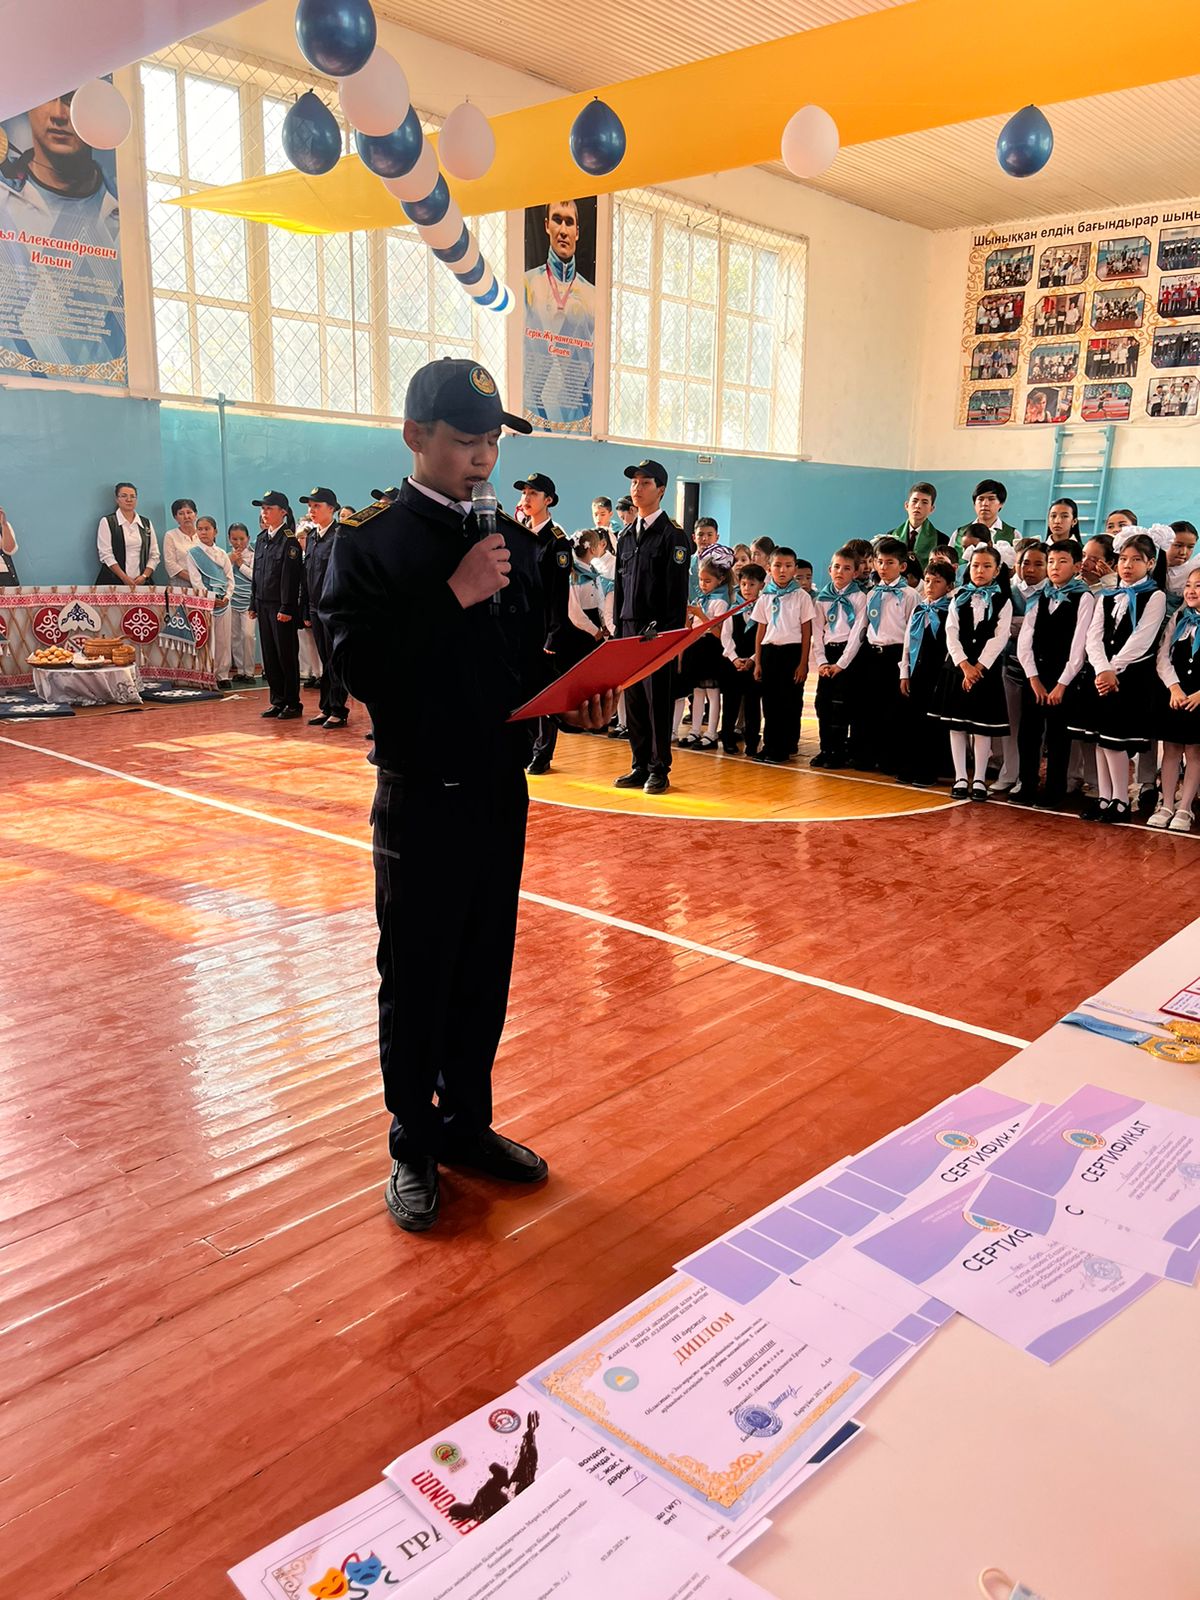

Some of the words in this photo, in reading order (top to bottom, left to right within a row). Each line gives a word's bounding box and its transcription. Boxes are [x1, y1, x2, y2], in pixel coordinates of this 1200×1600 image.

[18, 230, 117, 259] Александрович
[974, 230, 1038, 247] Шыныққан
[1041, 224, 1074, 238] елдің
[1078, 214, 1158, 234] бағындырар
[31, 250, 72, 269] Ильин
[1081, 1120, 1151, 1183] СЕРТИФИКАТ
[673, 1311, 735, 1366] ДИПЛОМ
